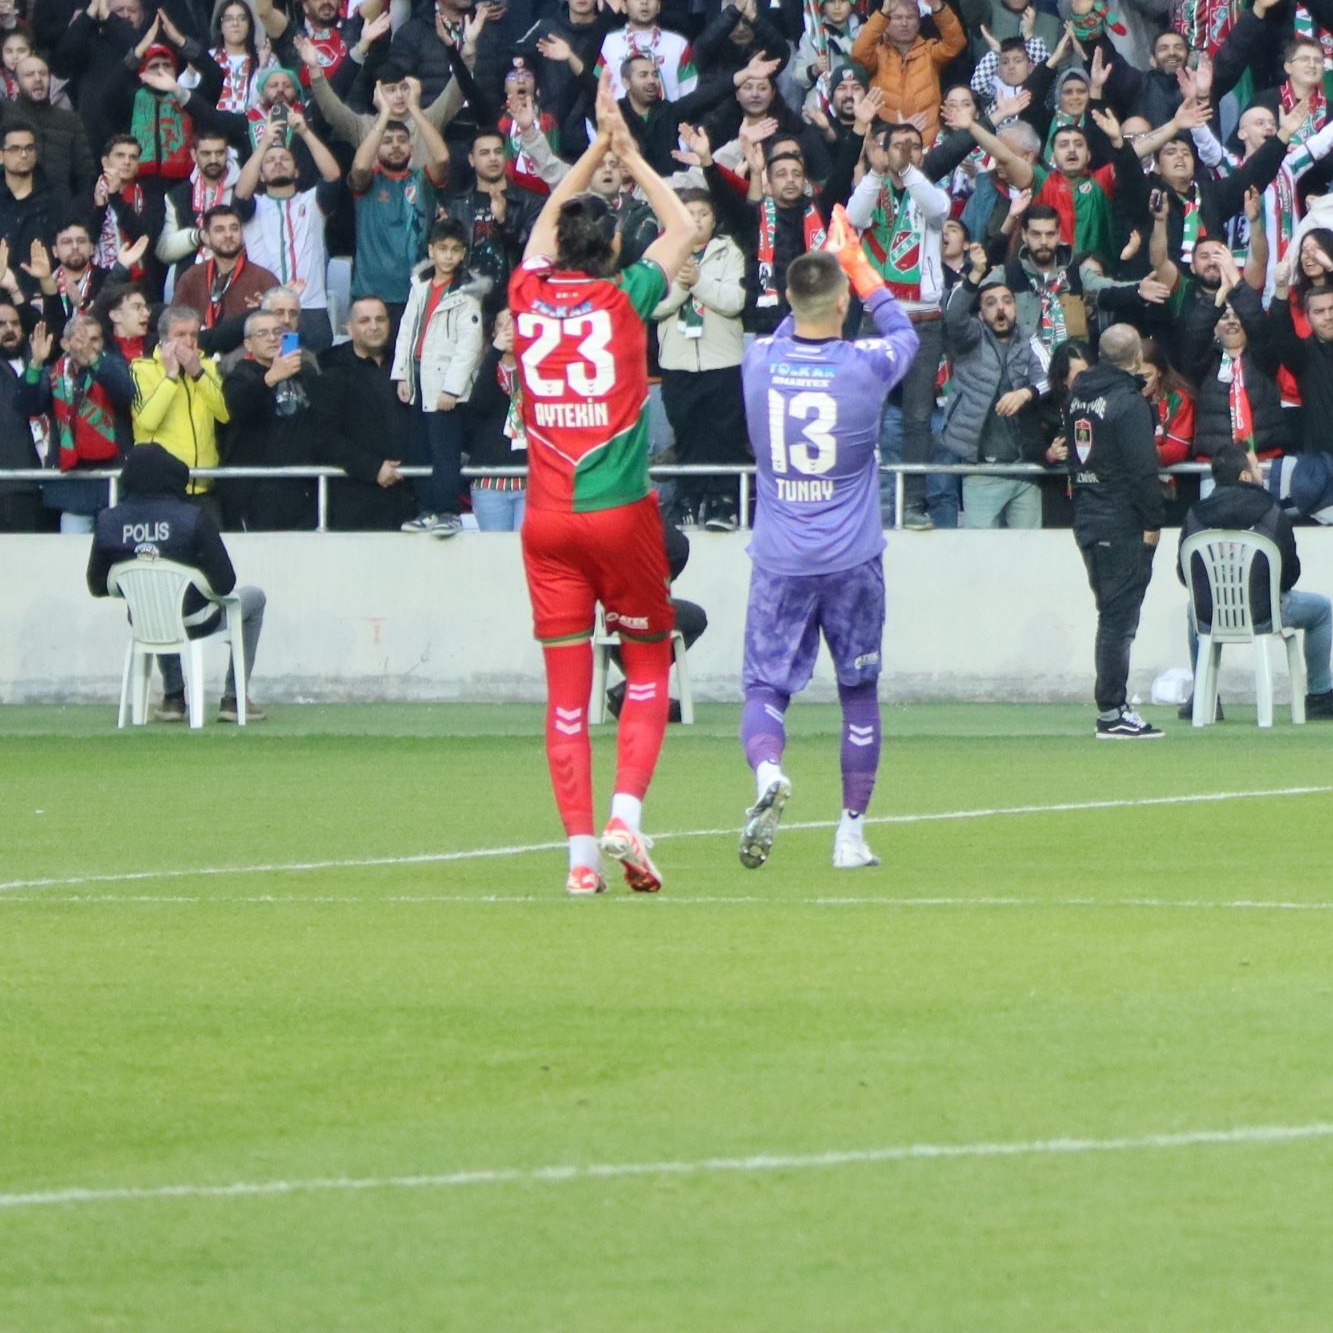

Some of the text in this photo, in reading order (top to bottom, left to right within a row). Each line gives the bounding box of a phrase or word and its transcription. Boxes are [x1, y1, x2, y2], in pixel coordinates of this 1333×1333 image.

[517, 309, 616, 397] 23
[769, 363, 836, 378] TOLKAR
[534, 398, 608, 427] AYTEKİN
[768, 388, 838, 474] 13
[775, 479, 834, 501] TUNAY
[122, 522, 170, 543] POLIS
